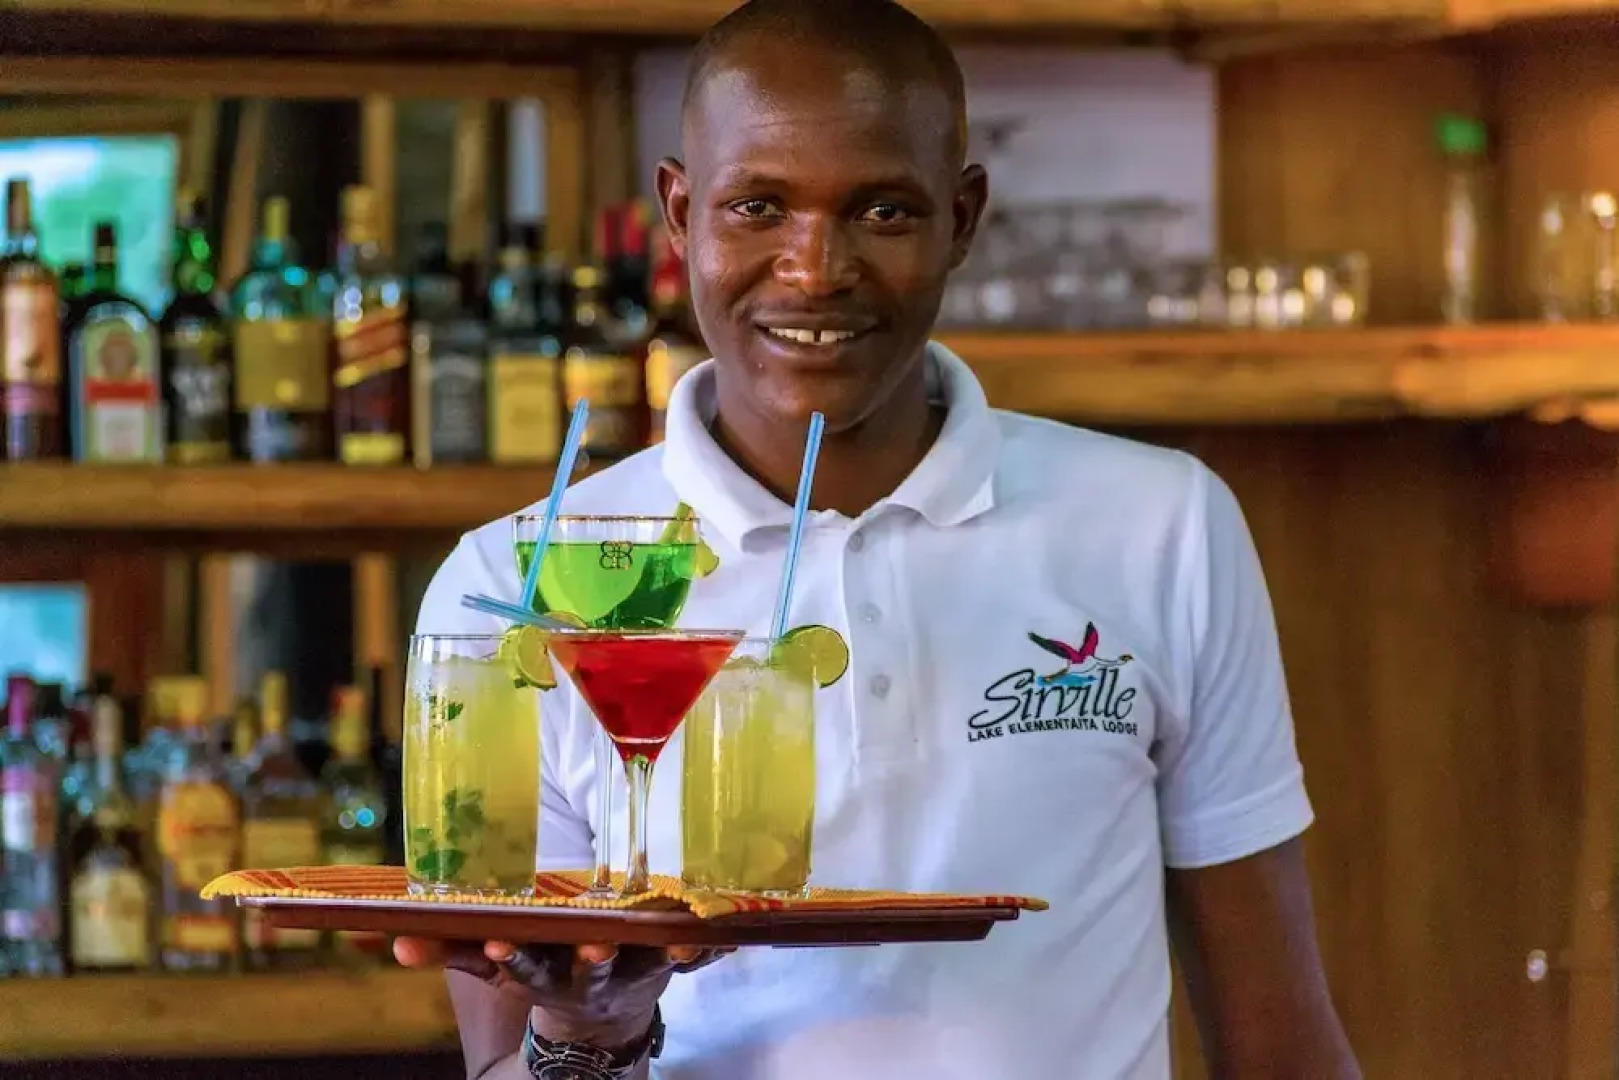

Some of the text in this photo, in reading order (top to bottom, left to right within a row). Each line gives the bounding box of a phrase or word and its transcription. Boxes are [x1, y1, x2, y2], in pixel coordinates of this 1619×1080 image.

[968, 667, 1136, 729] Sirville
[968, 719, 1138, 742] LAKE ELEMENTAITA LODGE
